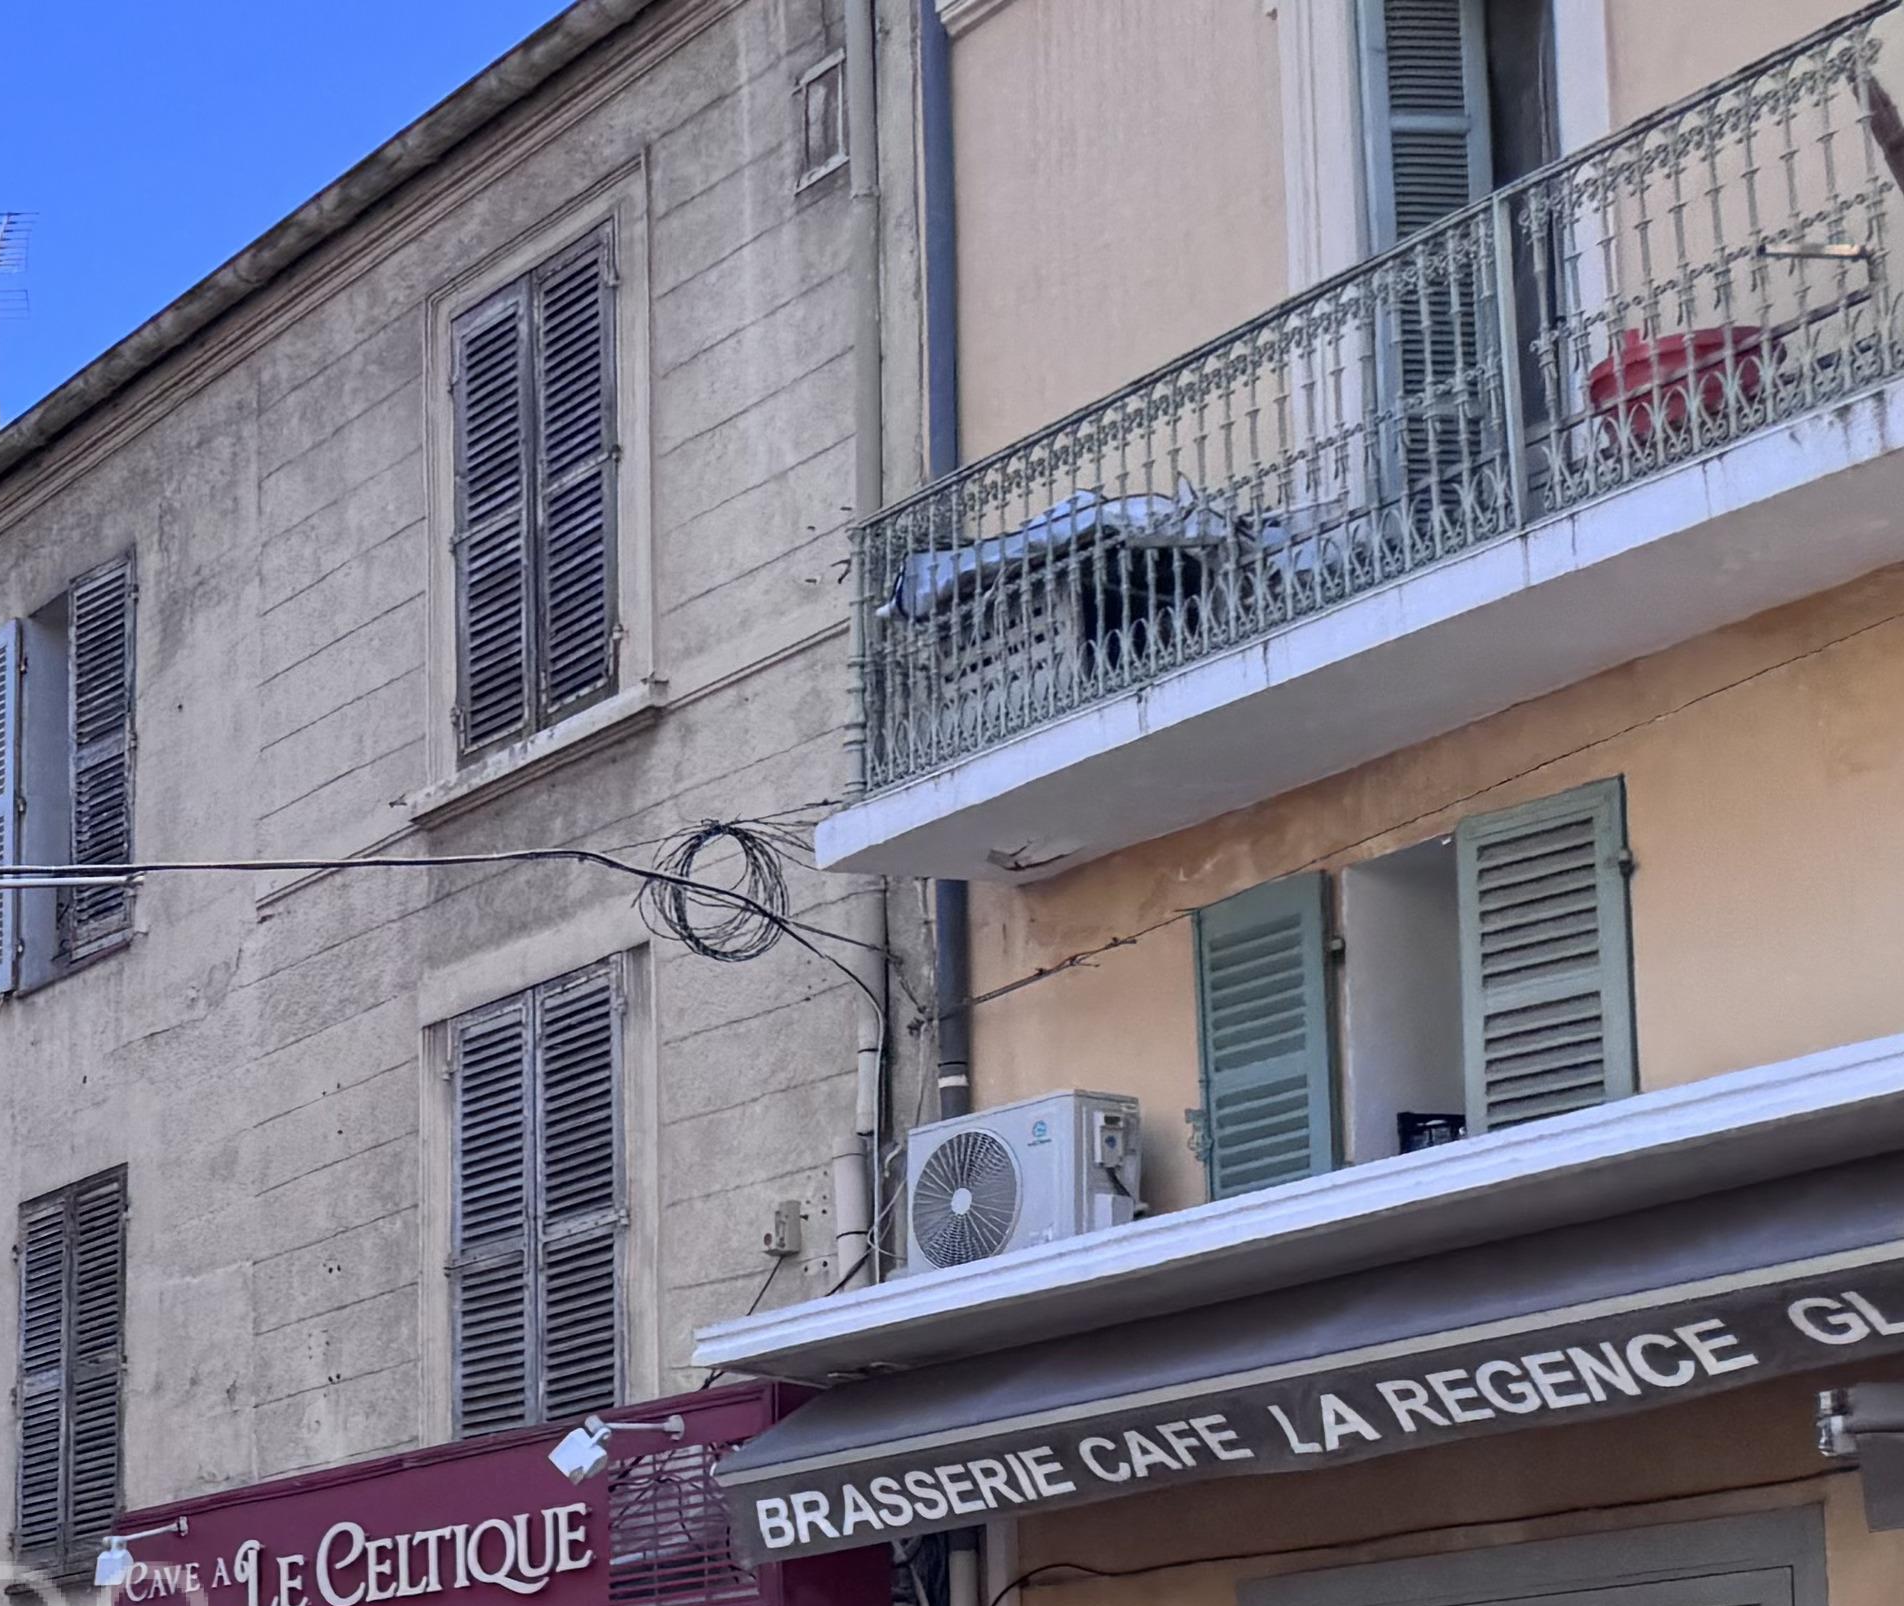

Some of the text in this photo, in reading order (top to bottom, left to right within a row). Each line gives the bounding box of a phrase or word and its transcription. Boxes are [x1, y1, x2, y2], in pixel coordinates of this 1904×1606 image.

[752, 1444, 1077, 1551] BRASSERIE
[1077, 1411, 1255, 1485] CAFE
[1268, 1391, 1382, 1457] LA
[1386, 1316, 1759, 1435] REGENCE
[124, 1560, 200, 1604] CAVE
